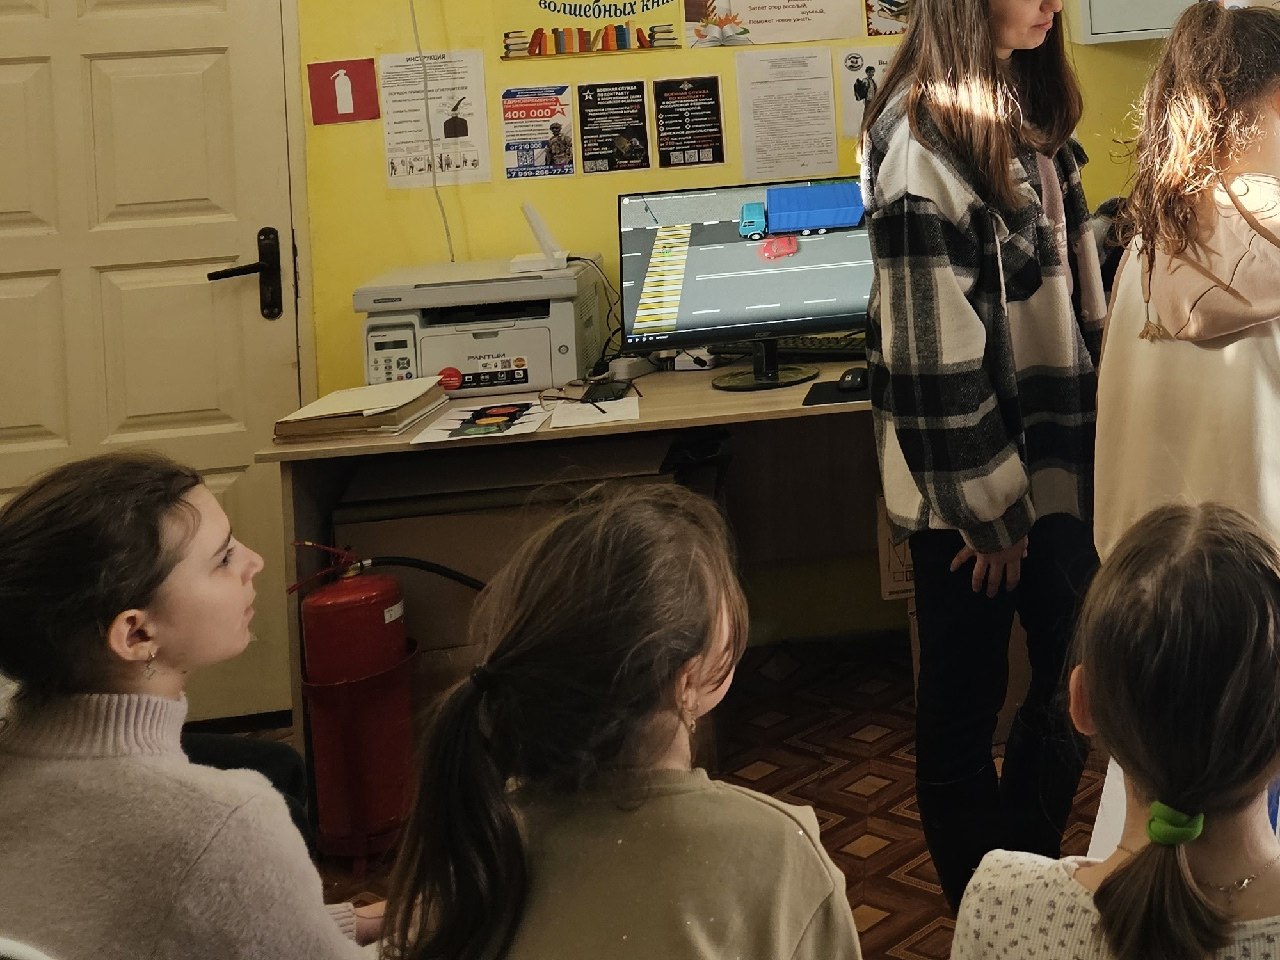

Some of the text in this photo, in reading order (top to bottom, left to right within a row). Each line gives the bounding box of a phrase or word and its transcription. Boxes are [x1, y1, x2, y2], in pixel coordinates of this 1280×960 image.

[504, 108, 552, 119] 400 000
[467, 352, 506, 361] PANTUM
